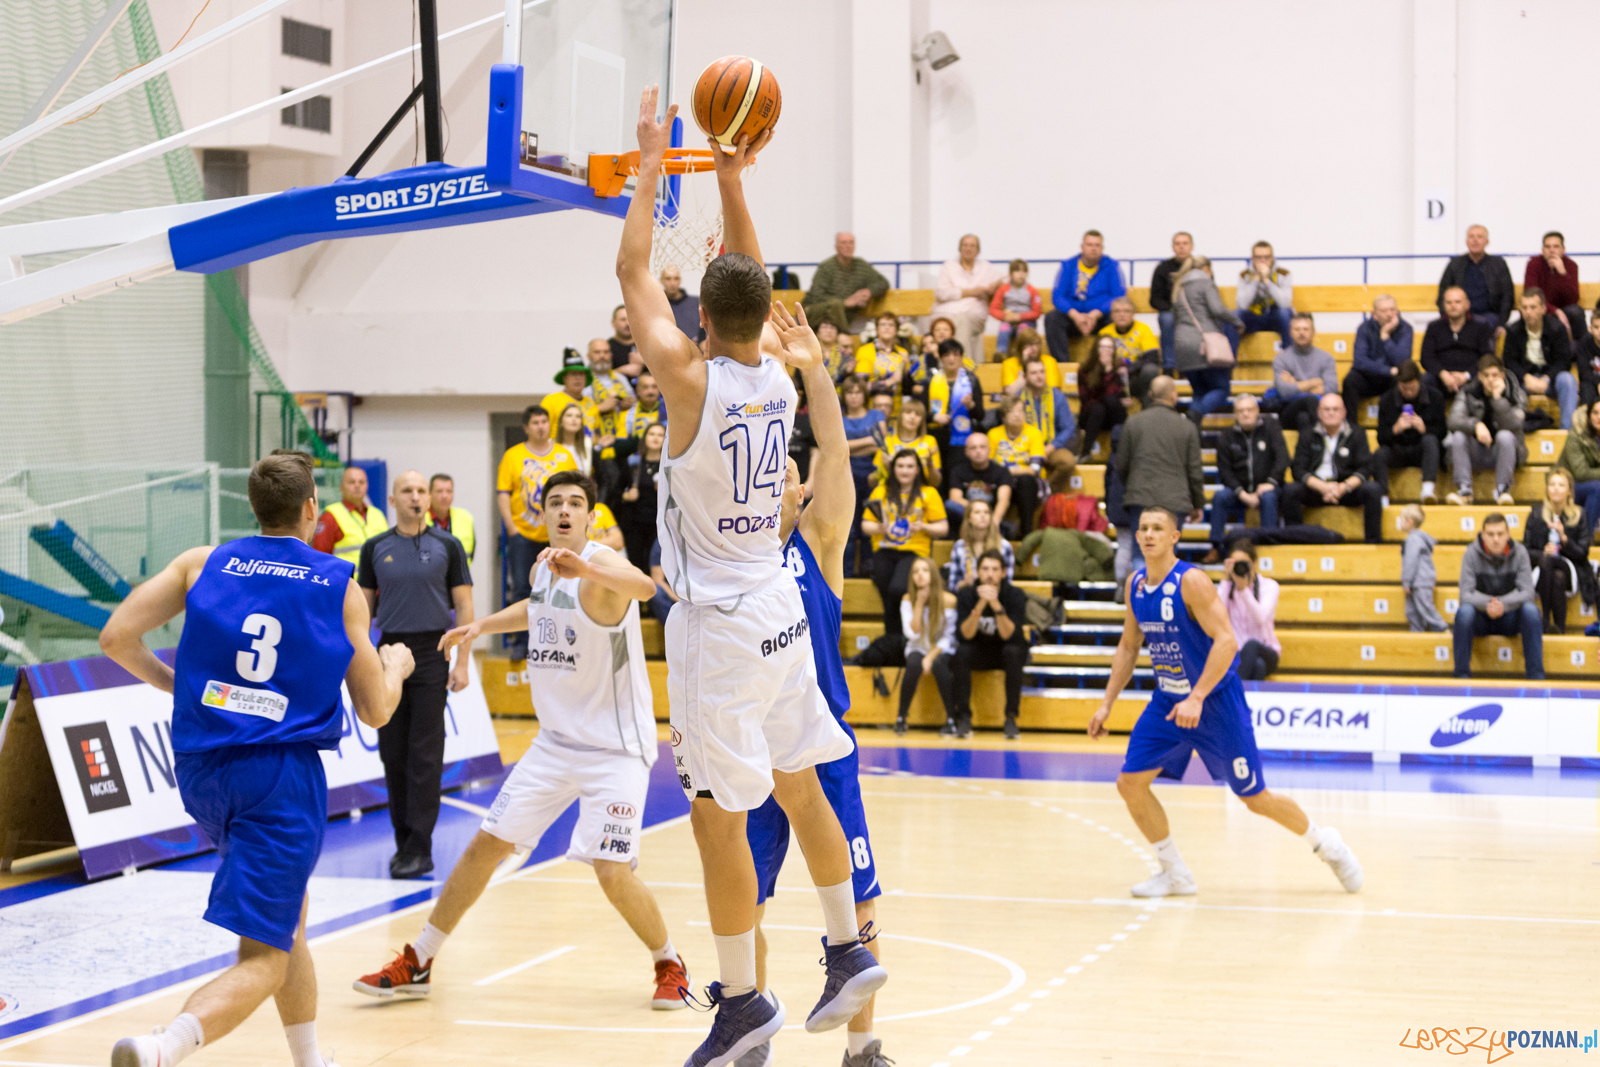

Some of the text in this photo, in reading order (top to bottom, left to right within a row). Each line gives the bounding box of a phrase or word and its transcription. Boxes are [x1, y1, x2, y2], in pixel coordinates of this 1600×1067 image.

[335, 187, 411, 214] SPORT
[1427, 199, 1445, 219] D
[745, 398, 787, 414] funclub
[719, 418, 787, 504] 14
[223, 556, 330, 586] Polfarmex S.A.
[1161, 596, 1175, 622] 6
[537, 617, 558, 644] 13
[236, 613, 282, 683] 3
[230, 687, 285, 711] drukarnia
[236, 702, 275, 715] SZMYDT
[1249, 706, 1370, 729] IOFARM
[1440, 716, 1491, 735] atrem
[1232, 757, 1250, 780] 6
[90, 779, 118, 797] NICKEL
[612, 805, 633, 816] KIA
[603, 823, 633, 836] DELIK
[610, 839, 631, 854] PBG
